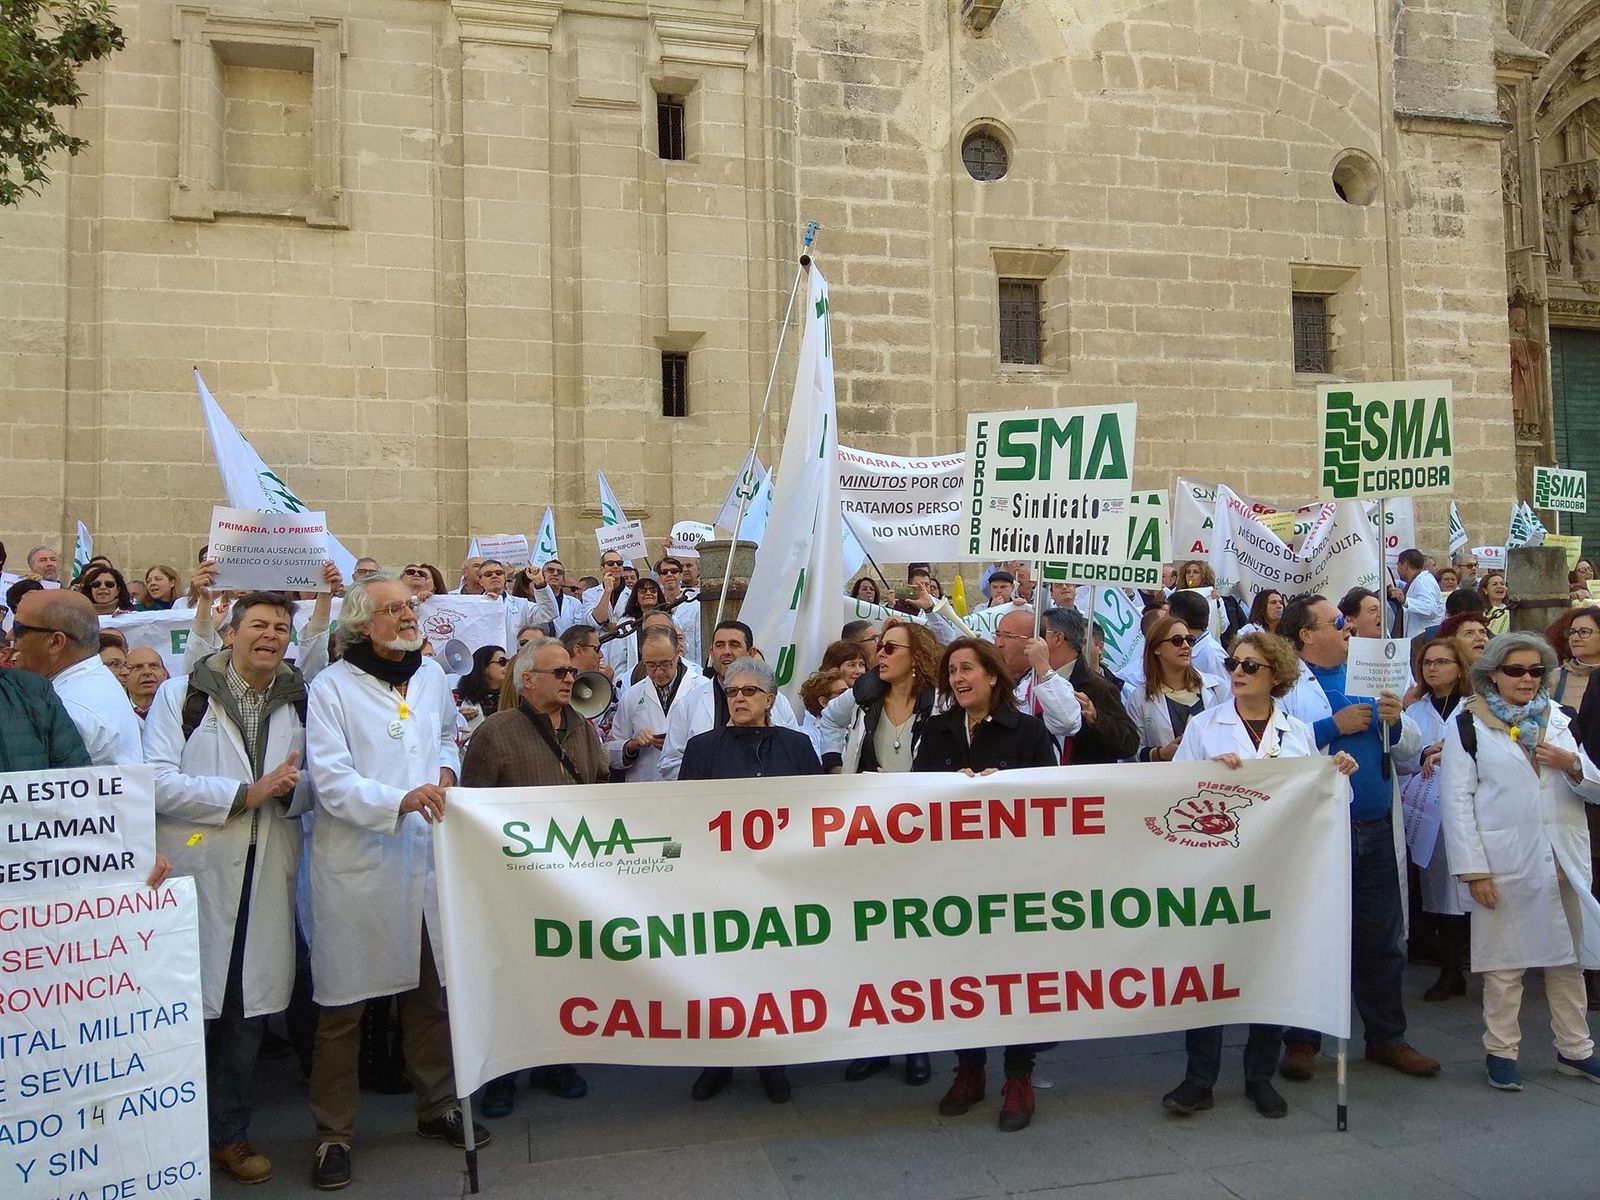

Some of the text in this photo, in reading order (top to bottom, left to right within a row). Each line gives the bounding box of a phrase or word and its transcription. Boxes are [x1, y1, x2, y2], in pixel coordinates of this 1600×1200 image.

[1362, 398, 1451, 461] SMA
[996, 413, 1128, 481] SMA
[909, 461, 928, 469] LO
[1363, 465, 1450, 492] CÓRDOBA
[840, 475, 907, 489] MINUTOS
[911, 476, 938, 488] POR
[969, 421, 988, 554] CÓRDOBA
[1550, 475, 1585, 499] SMA
[841, 500, 913, 514] TRATAMOS
[1012, 492, 1100, 519] Sindicato
[218, 521, 270, 534] PRIMARIA,
[288, 525, 324, 534] PRIMERO
[601, 535, 625, 544] Libertad
[676, 532, 706, 543] 100%
[872, 524, 960, 537] NO NÚMERO
[990, 527, 1110, 555] Médico Andaluz
[214, 543, 265, 554] COBERTURA
[266, 546, 307, 555] AUSENCIA
[1238, 525, 1281, 557] MÉDICOS
[1284, 548, 1300, 563] DE
[271, 558, 283, 566] SU
[1284, 571, 1312, 584] POR
[27, 779, 89, 802] ESTO
[98, 777, 122, 796] LE
[1197, 781, 1271, 801] Plataforma
[8, 815, 115, 843] LLAMAN
[812, 796, 1106, 848] PACIENTE
[502, 815, 636, 861] SMA
[1163, 832, 1178, 843] Ya
[1179, 839, 1230, 848] Huelva
[506, 856, 666, 871] Sindicato Médico Andaluz
[617, 863, 674, 876] Huelva
[534, 884, 1271, 961] DIGNIDAD PROFESIONAL
[2, 929, 154, 973] SEVILLA Y
[0, 972, 141, 1014] OVINCIA,
[559, 964, 1241, 1040] CALIDAD ASISTENCIAL
[79, 1002, 189, 1044] MILITAR
[20, 1053, 145, 1097] SEVILLA
[77, 1105, 105, 1130] 14
[119, 1081, 196, 1121] AÑOS
[16, 1144, 98, 1183] Y SIN
[102, 1161, 202, 1200] DE USO.
